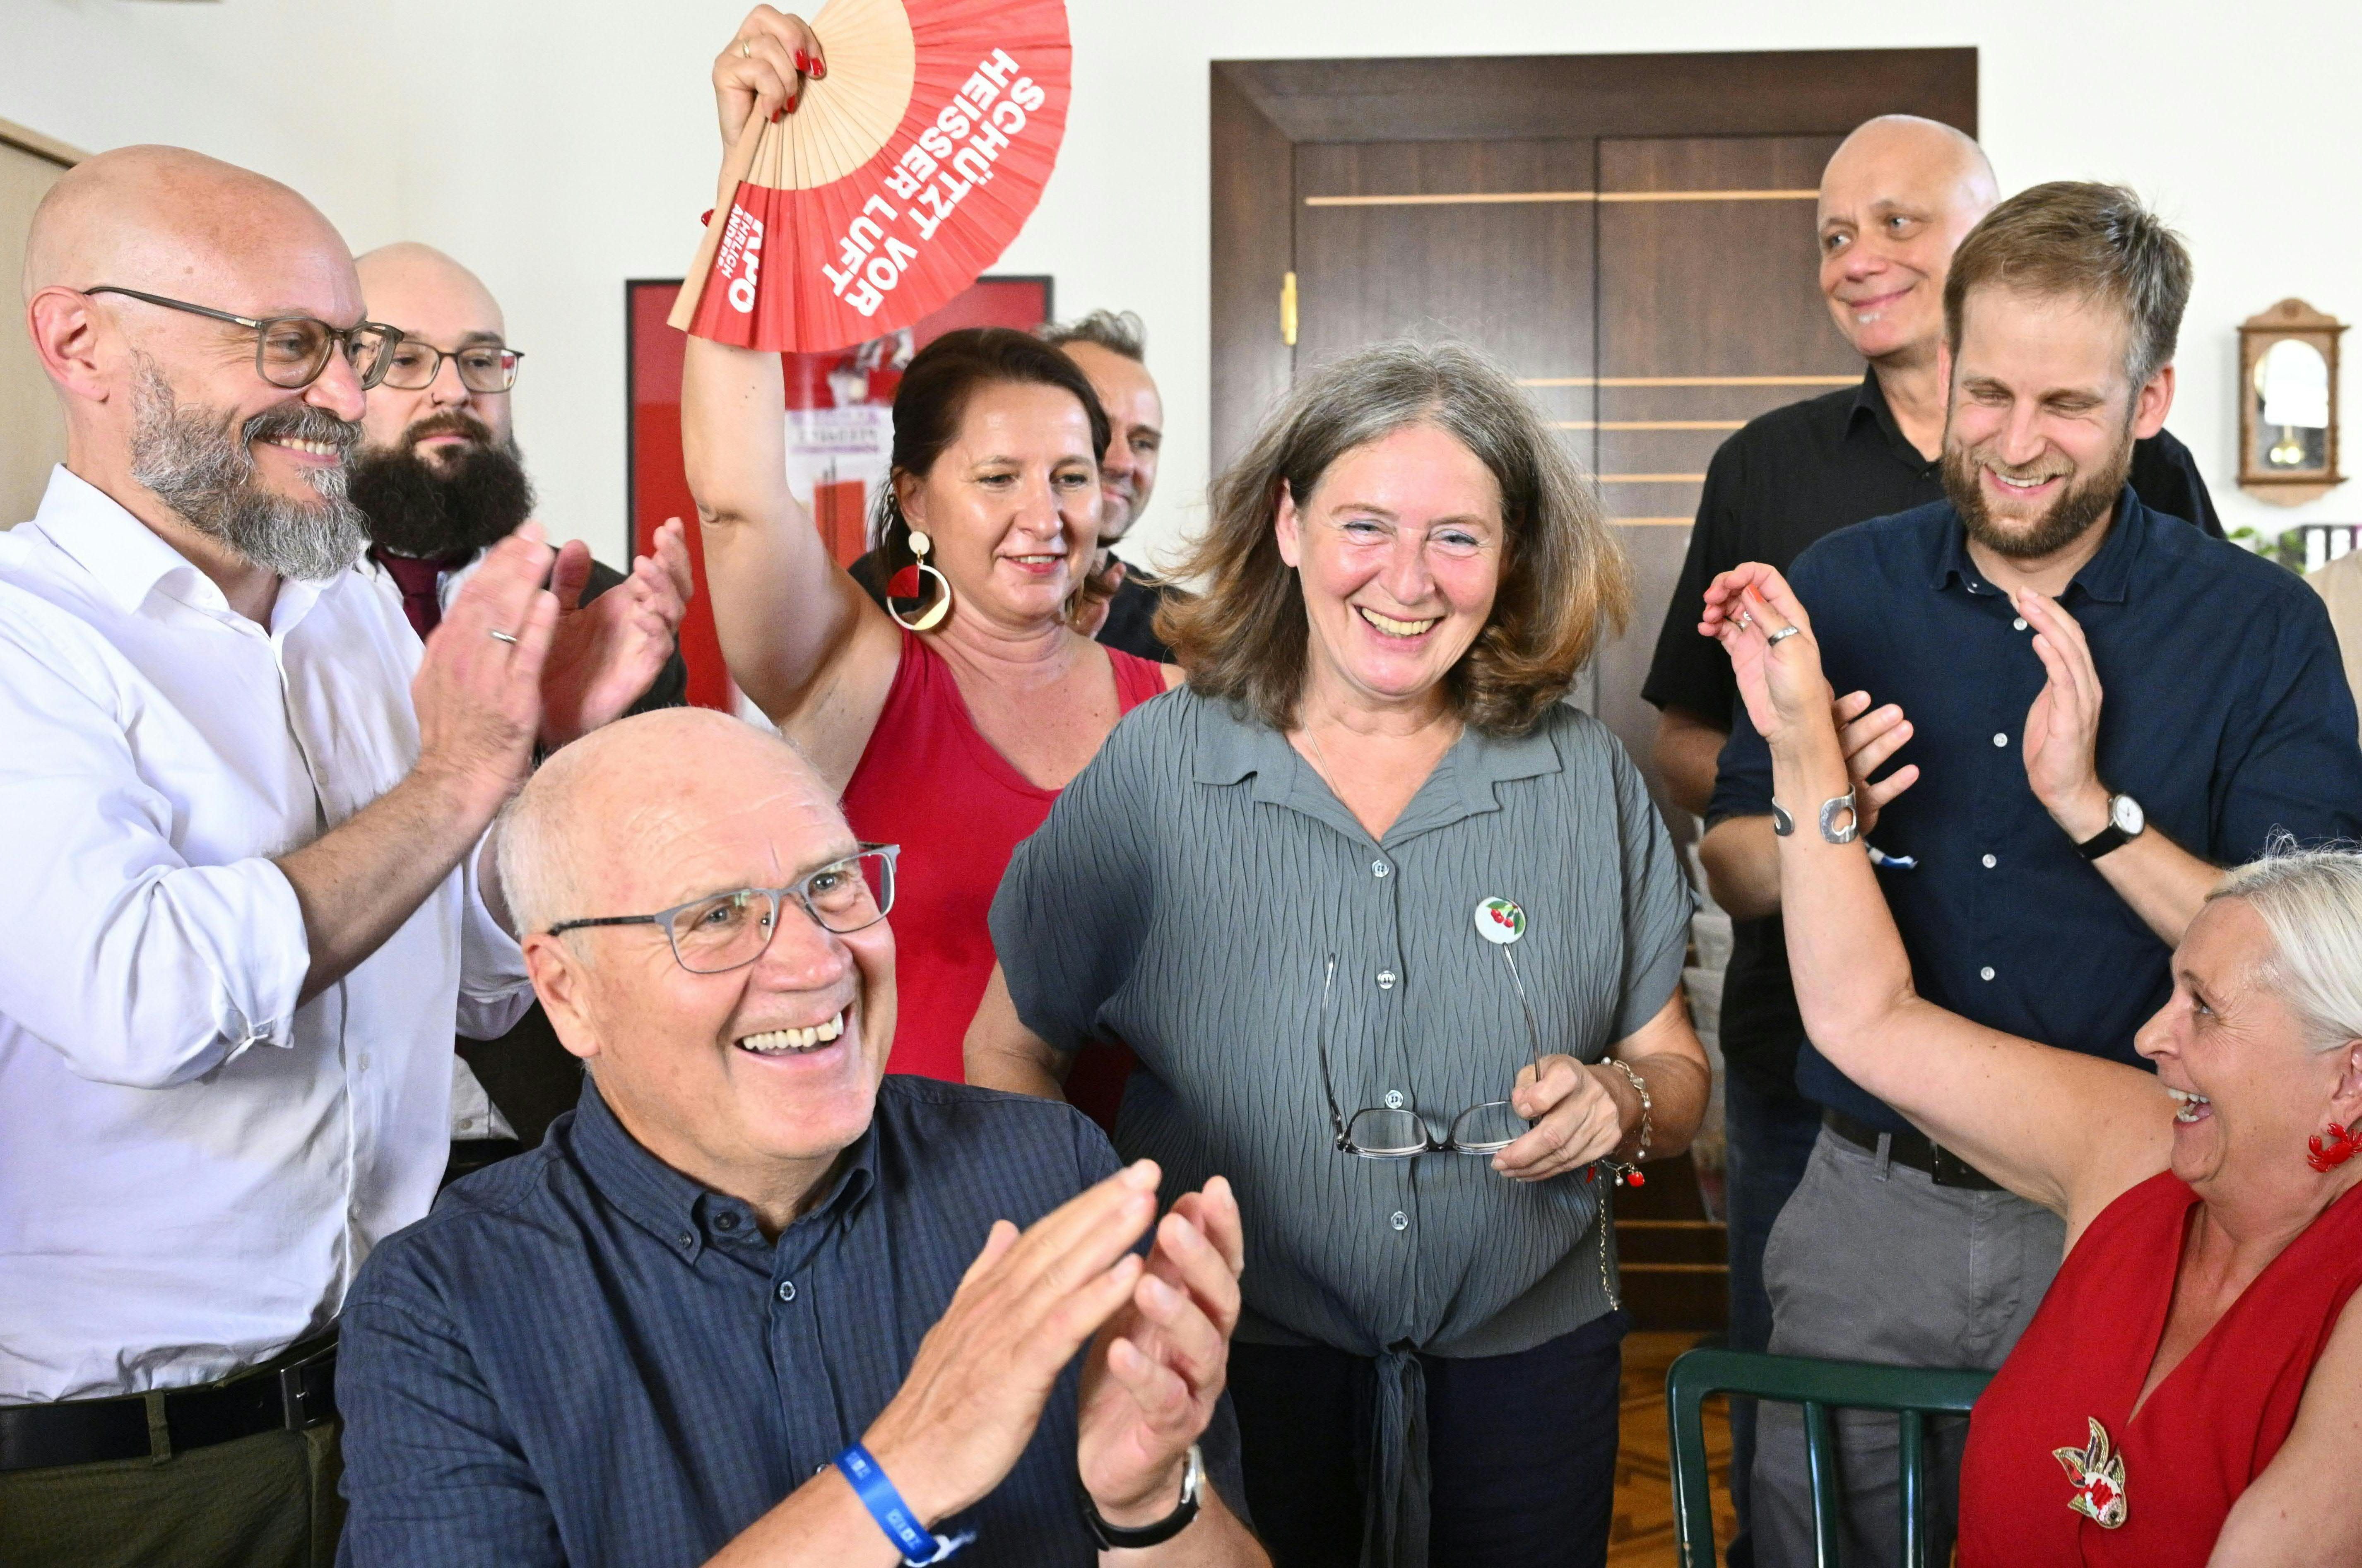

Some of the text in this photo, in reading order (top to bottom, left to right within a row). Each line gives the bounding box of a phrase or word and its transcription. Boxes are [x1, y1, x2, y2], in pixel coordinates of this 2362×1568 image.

[884, 47, 1020, 200] HEISSER
[721, 211, 754, 280] EHRLICH
[821, 193, 898, 297] LUFT
[844, 77, 1045, 317] SCHÜTZT VOR
